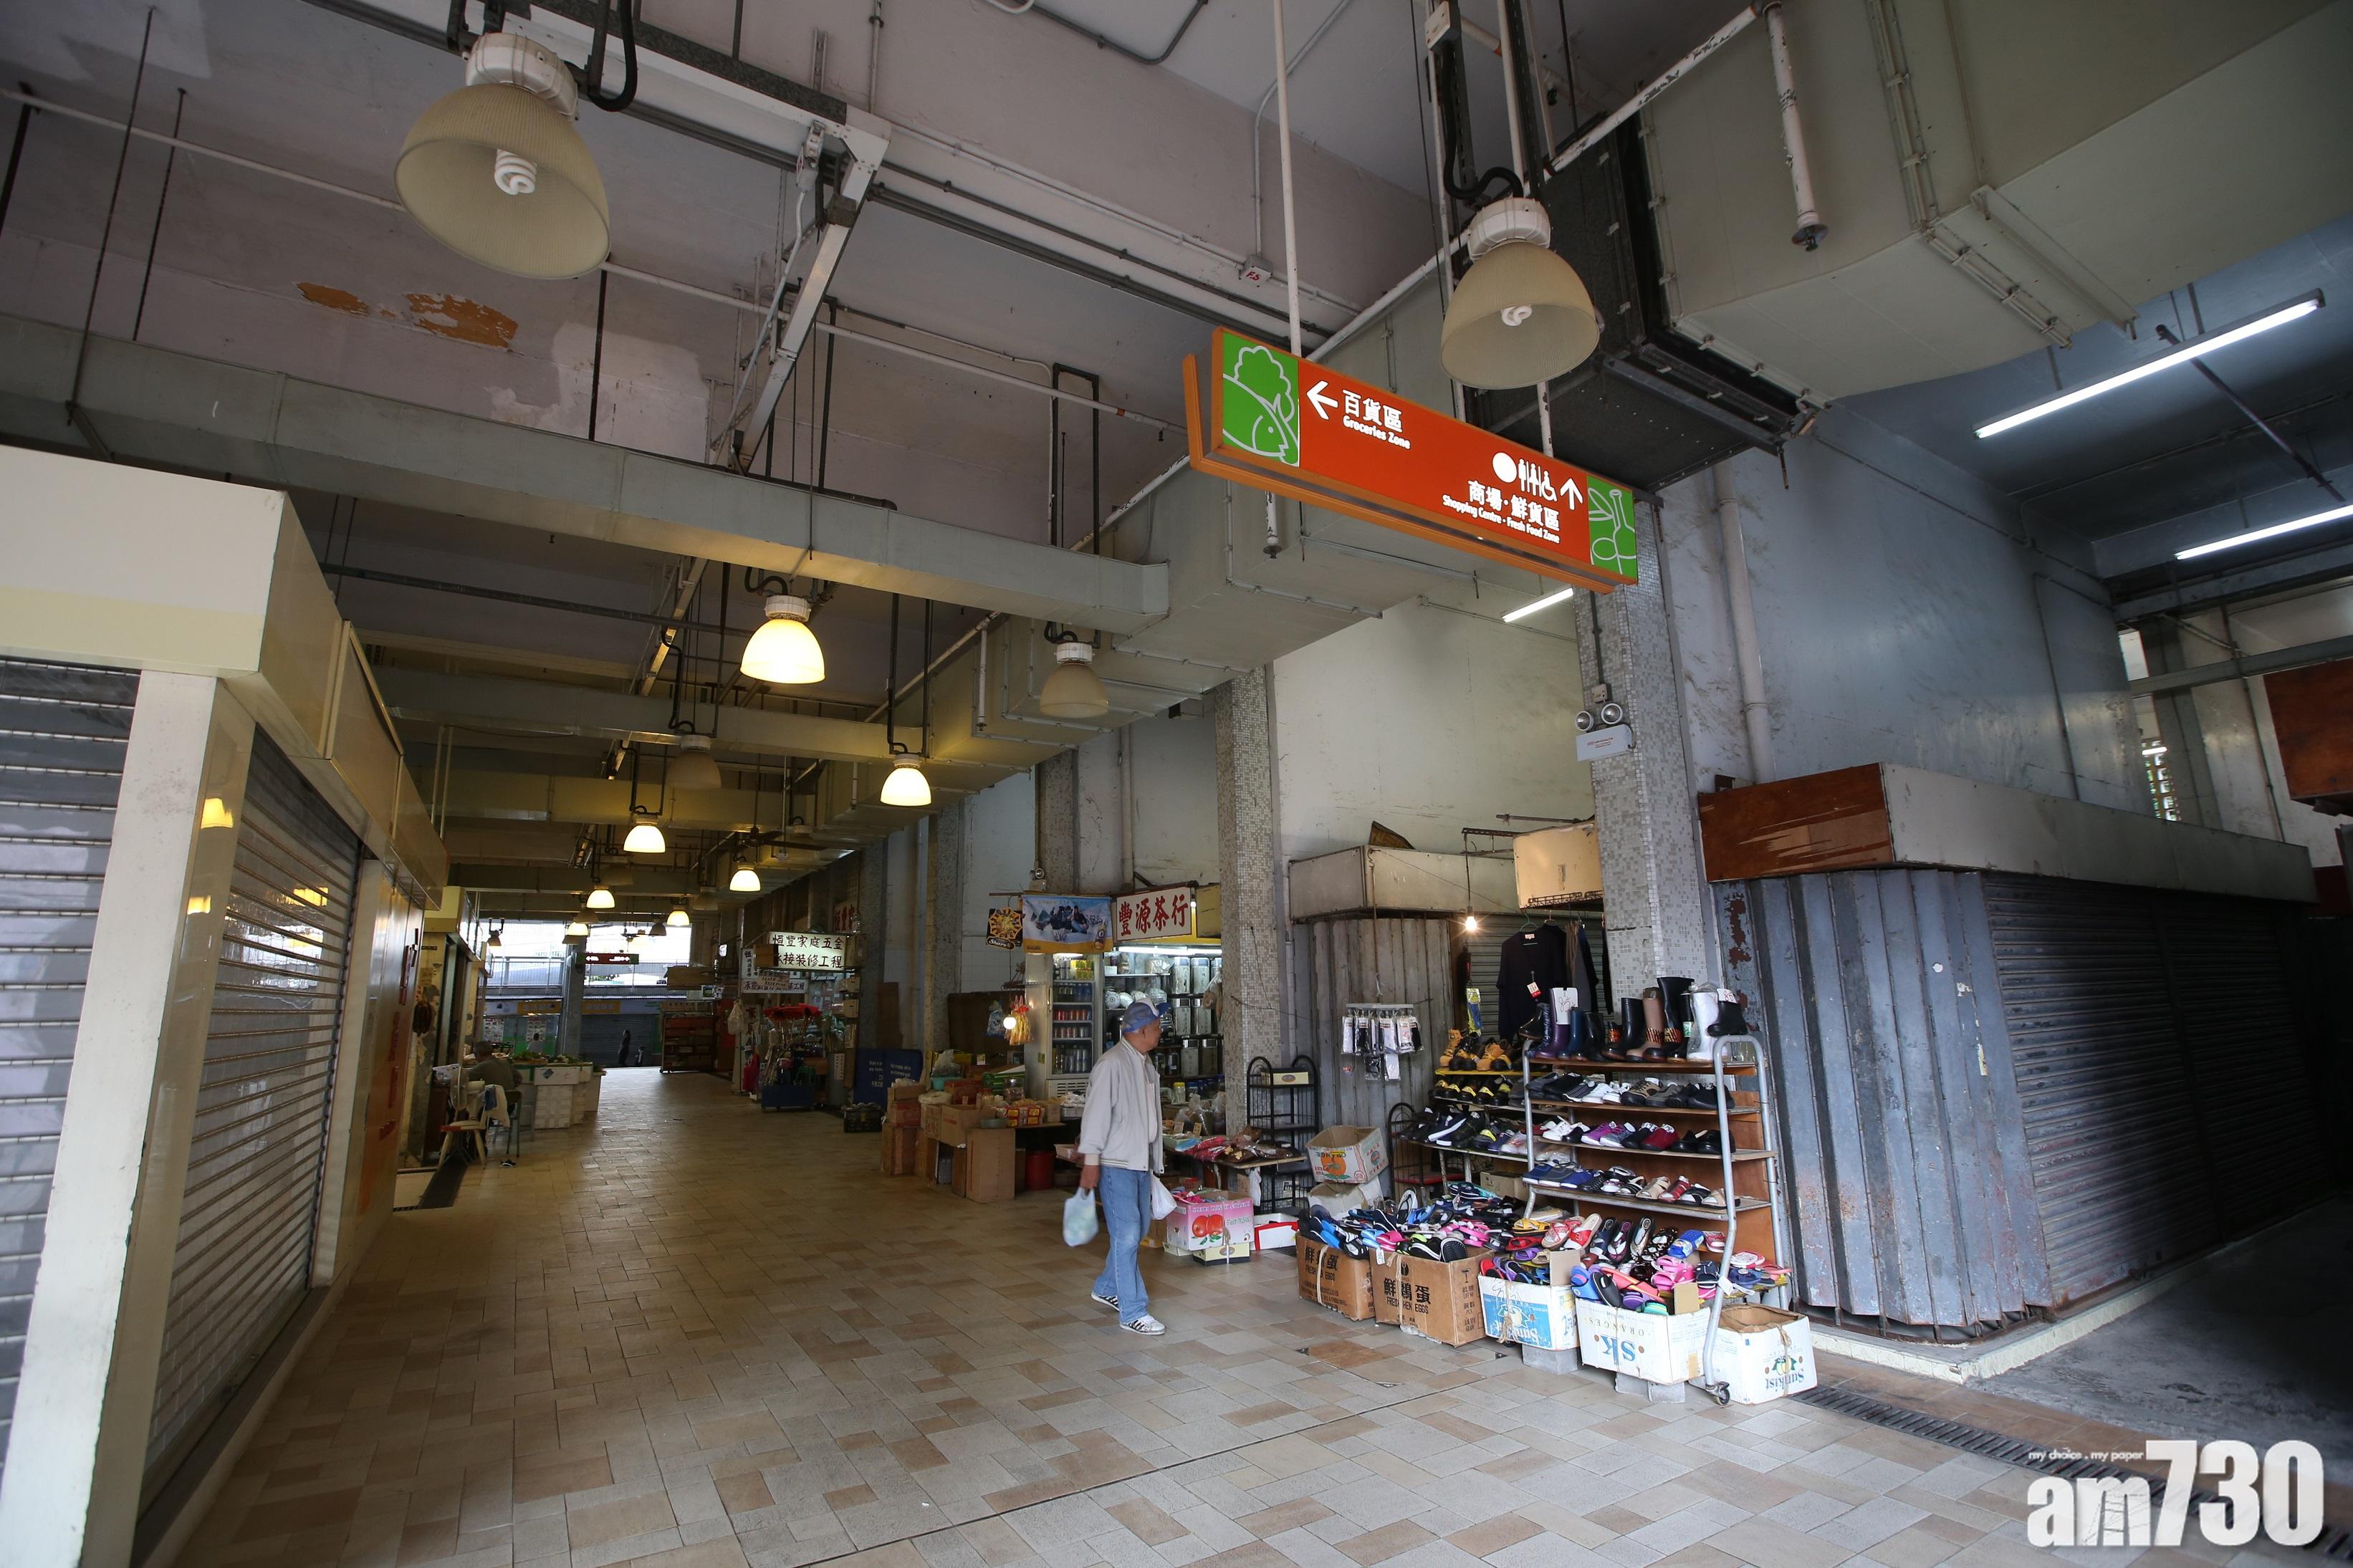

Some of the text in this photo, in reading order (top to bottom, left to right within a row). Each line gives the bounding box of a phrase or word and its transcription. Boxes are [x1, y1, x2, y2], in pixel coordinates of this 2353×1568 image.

[1342, 389, 1403, 433] 百貨區
[1343, 415, 1411, 450] Groceries Zone
[1442, 494, 1560, 544] Shopping Centre Fresh Food Zone
[1118, 893, 1189, 937] 豐源茶行
[1414, 1303, 1429, 1314] EGGS
